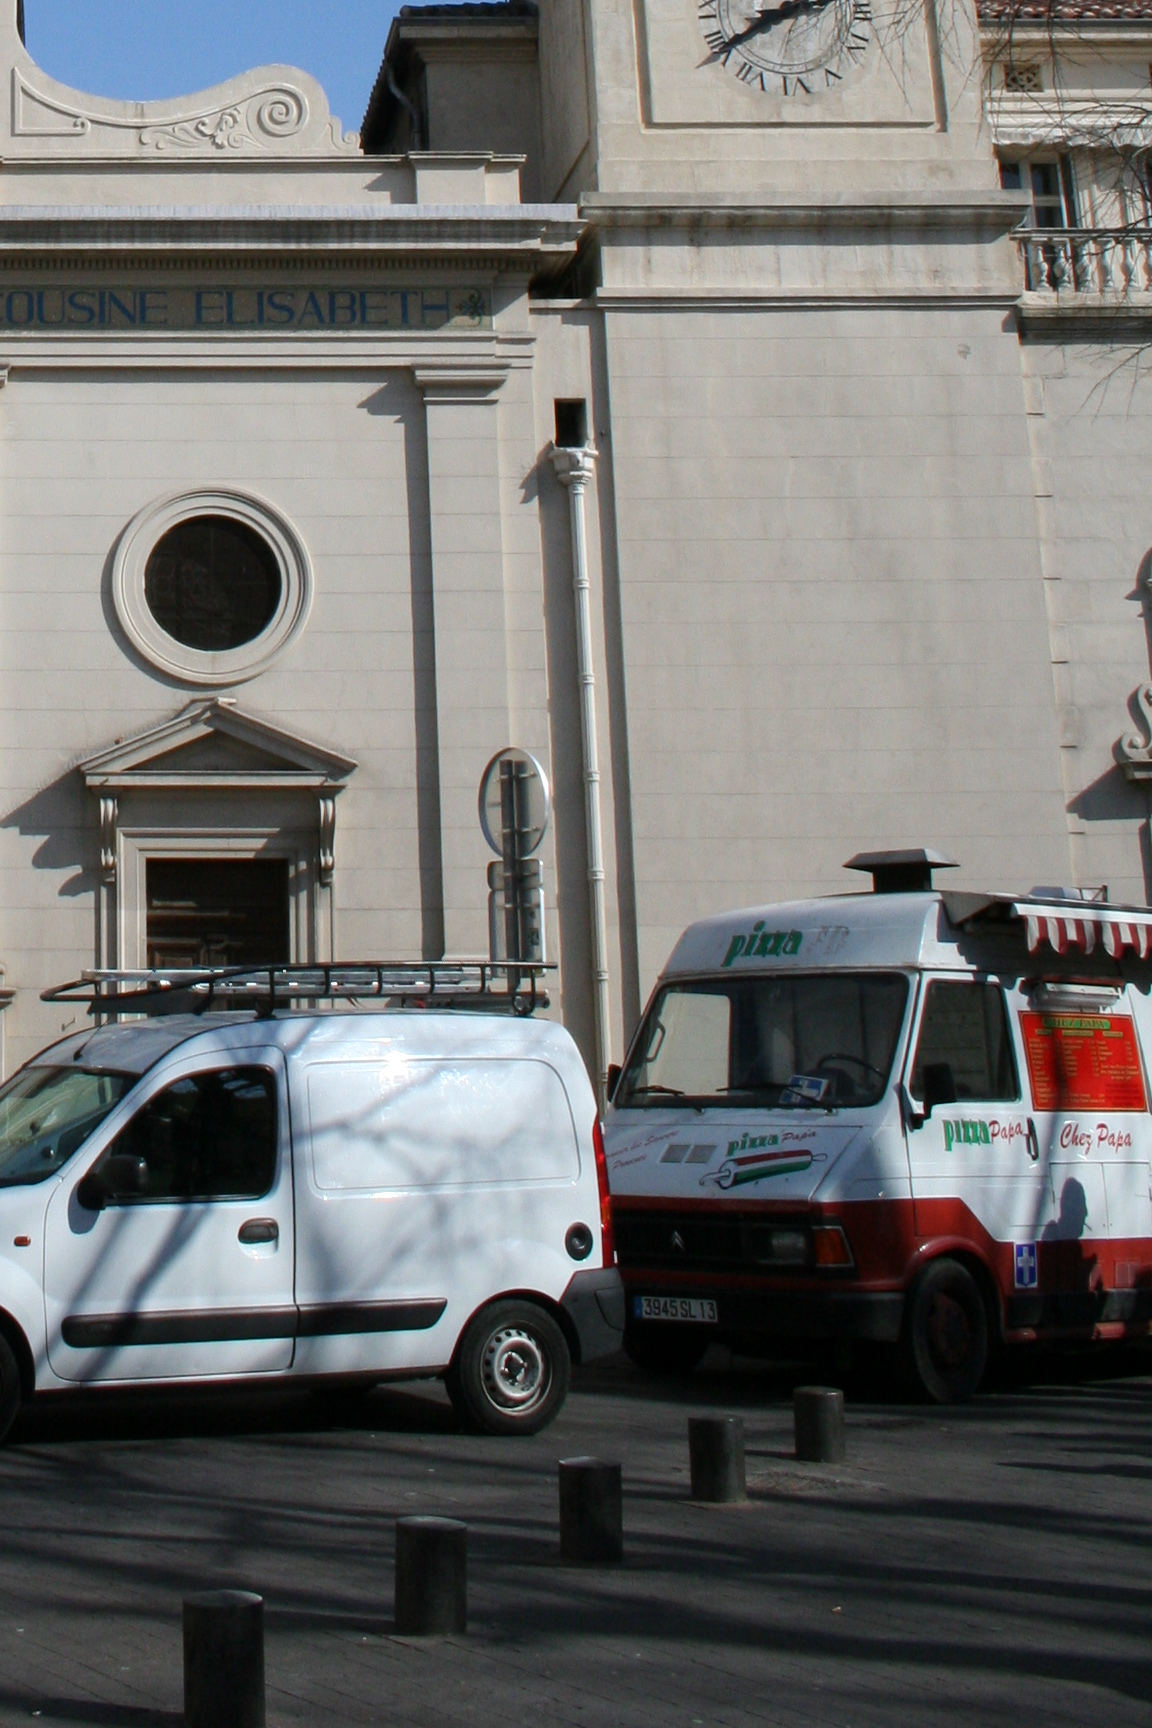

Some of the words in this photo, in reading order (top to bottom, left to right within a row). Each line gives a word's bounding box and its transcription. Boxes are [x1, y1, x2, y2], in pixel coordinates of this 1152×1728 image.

[194, 290, 450, 326] ELISABETH
[720, 920, 803, 967] pizza
[725, 1132, 779, 1157] pizza
[941, 1119, 990, 1152] pizza
[988, 1120, 1023, 1145] Papa
[1059, 1123, 1093, 1156] Chez
[1096, 1123, 1133, 1154] Papa
[644, 1298, 678, 1318] 3945
[680, 1301, 696, 1319] SL
[700, 1302, 716, 1321] 13
